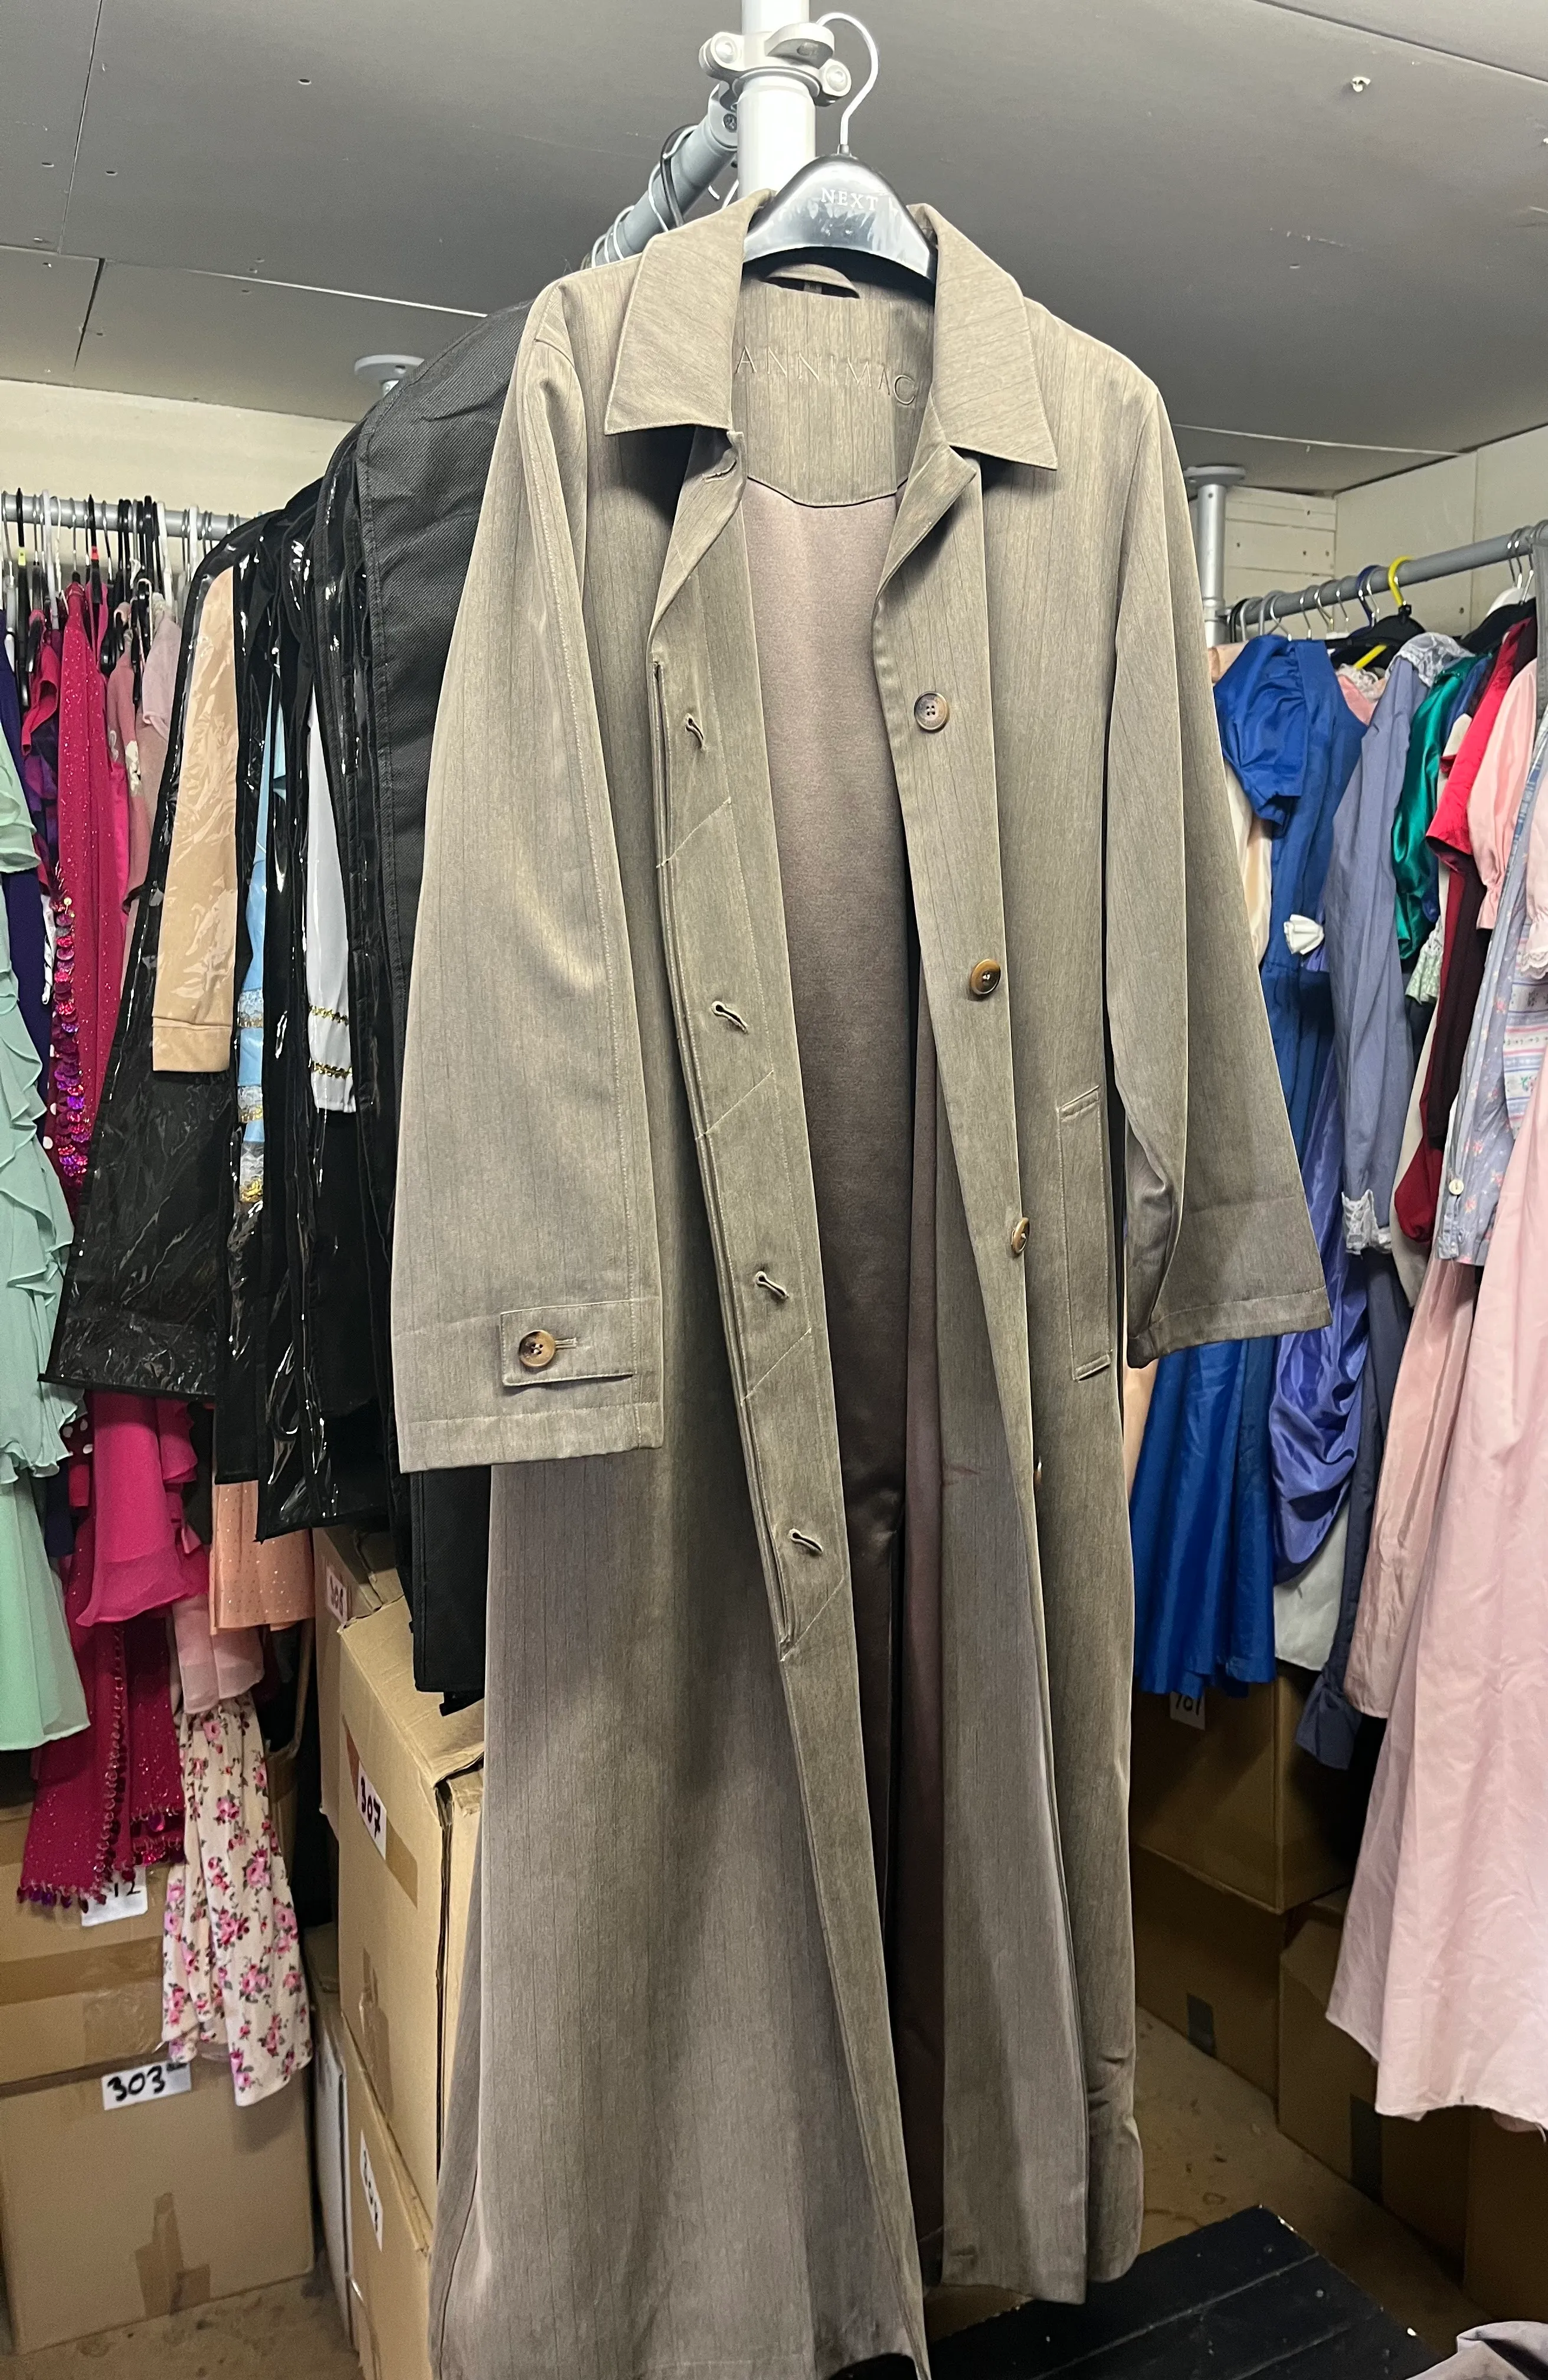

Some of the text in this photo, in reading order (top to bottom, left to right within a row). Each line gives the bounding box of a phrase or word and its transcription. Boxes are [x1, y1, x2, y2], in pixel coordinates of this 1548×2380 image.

[821, 187, 879, 211] NEXT
[361, 1775, 381, 1840] 307
[107, 2065, 166, 2102] 303
